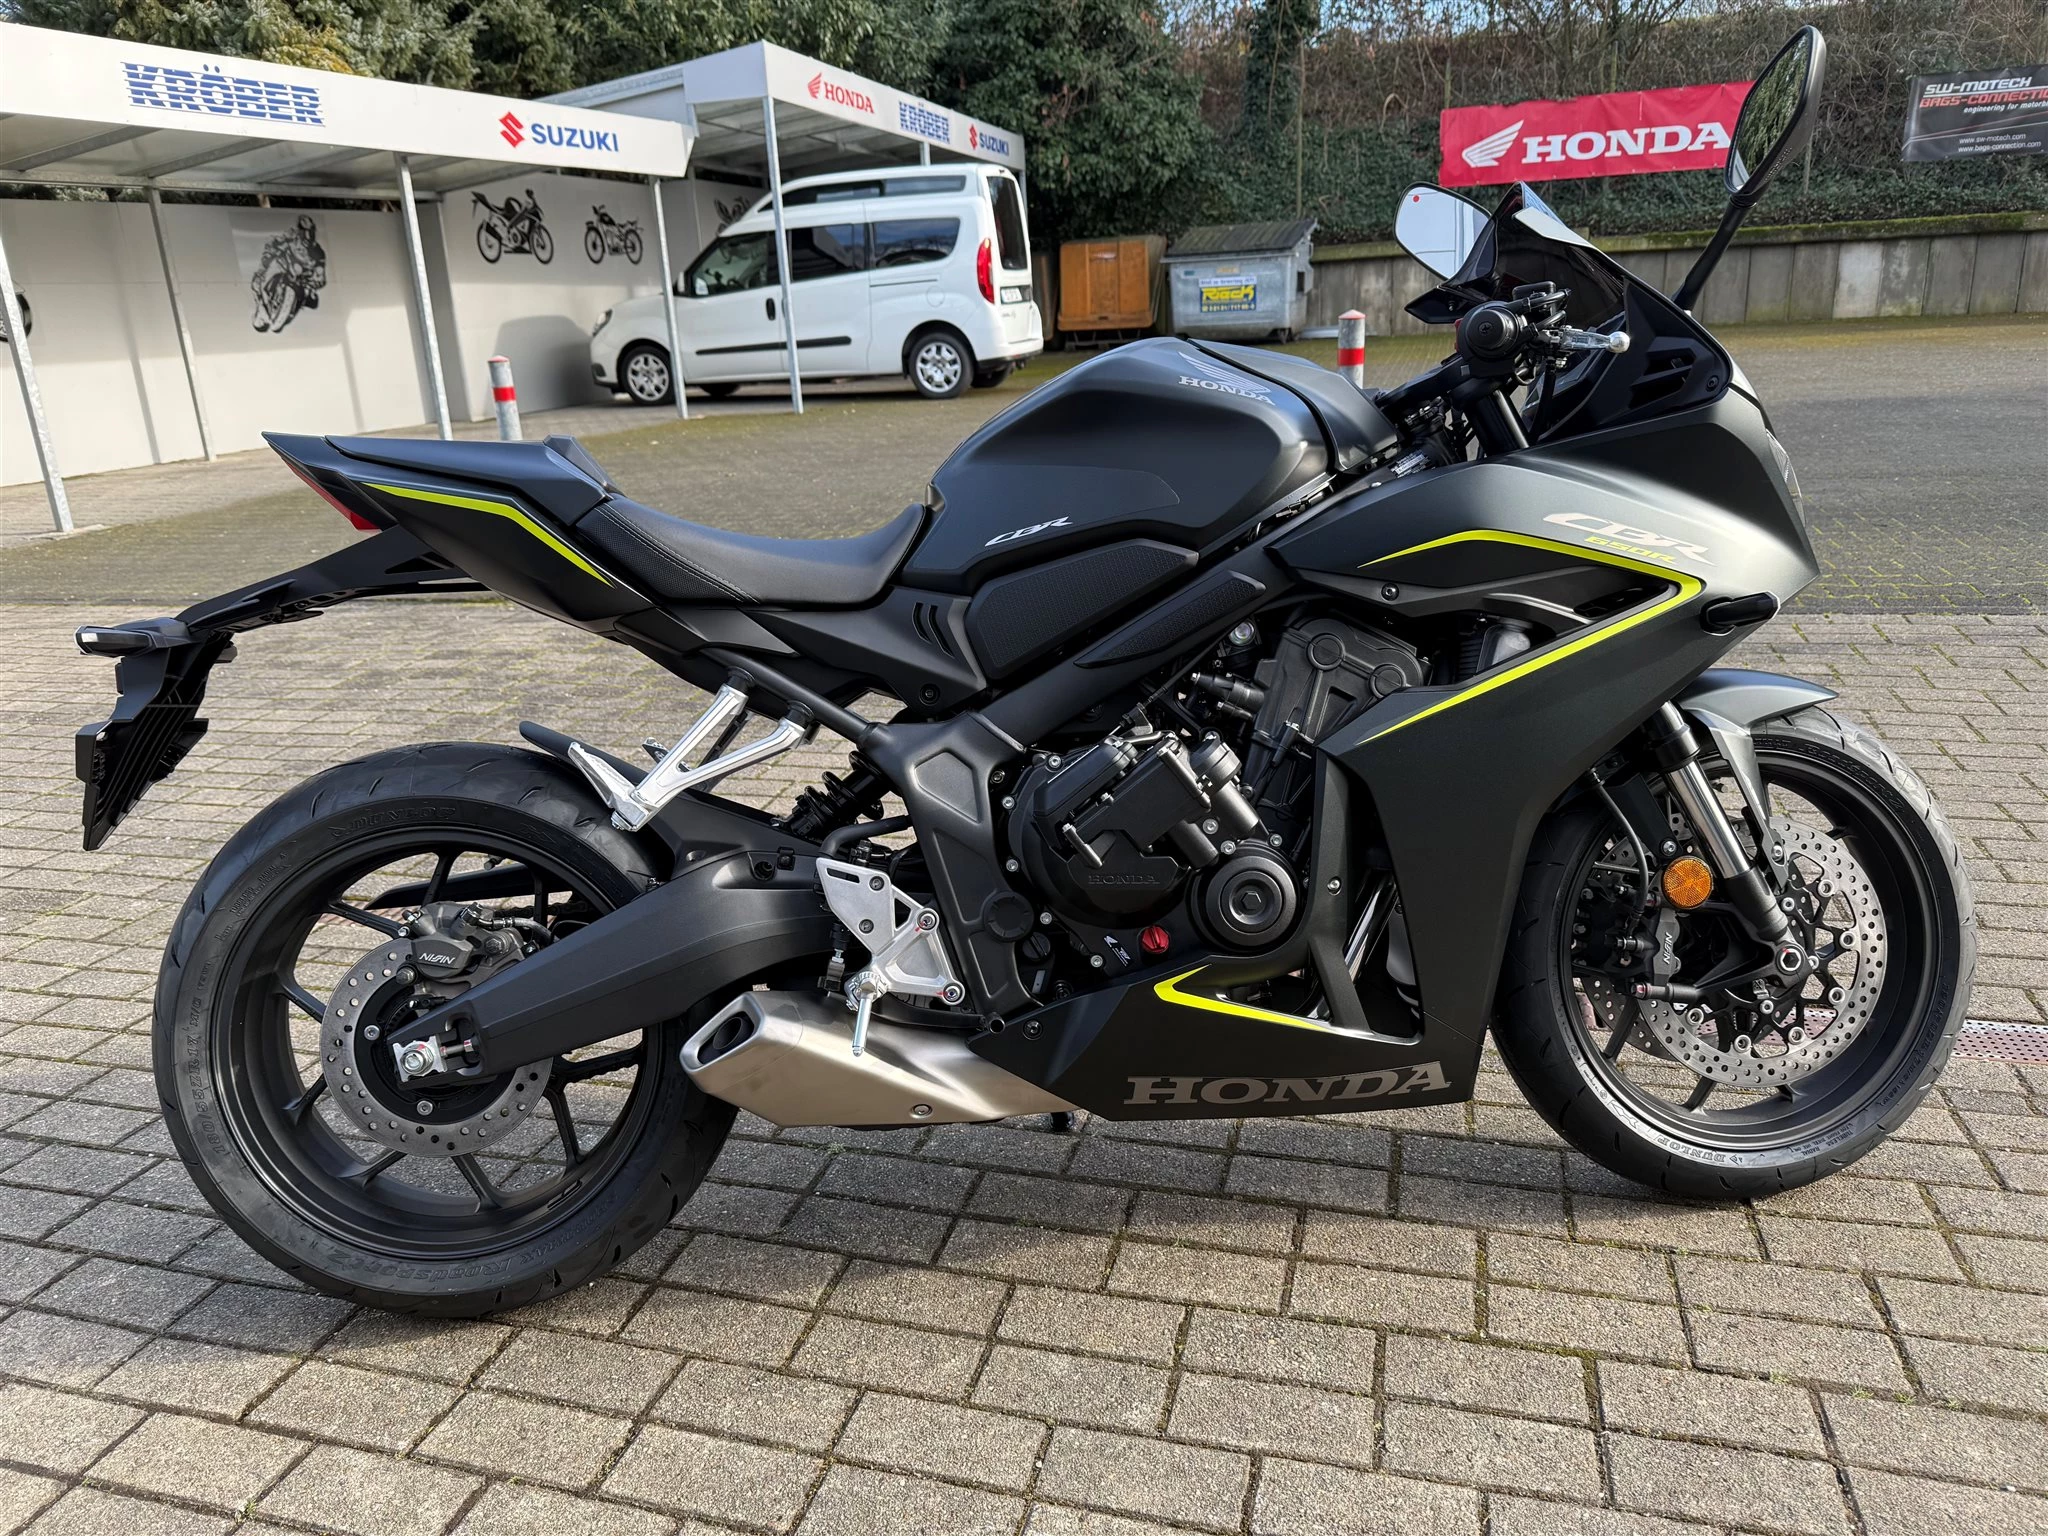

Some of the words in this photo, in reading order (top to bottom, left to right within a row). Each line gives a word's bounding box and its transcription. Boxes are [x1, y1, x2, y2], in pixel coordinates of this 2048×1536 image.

[120, 64, 325, 127] KRÖBER
[824, 81, 875, 114] HONDA
[1924, 77, 2032, 95] SW-MOTECH
[899, 102, 950, 144] KRÖBER
[1963, 104, 2005, 114] engineering
[2007, 102, 2018, 110] for
[531, 123, 619, 152] SUZUKI
[979, 132, 1010, 157] SUZUKI
[1522, 121, 1732, 164] HONDA
[1958, 134, 2026, 144] www.sw-motech.com
[1958, 141, 2041, 152] www.bags-connection.com
[1178, 375, 1276, 406] HONDA
[984, 516, 1073, 547] CBR
[1543, 512, 1718, 566] CBR
[1583, 536, 1681, 565] 650R
[1123, 1060, 1452, 1105] HONDA
[1656, 1134, 1726, 1163] DUNLOP
